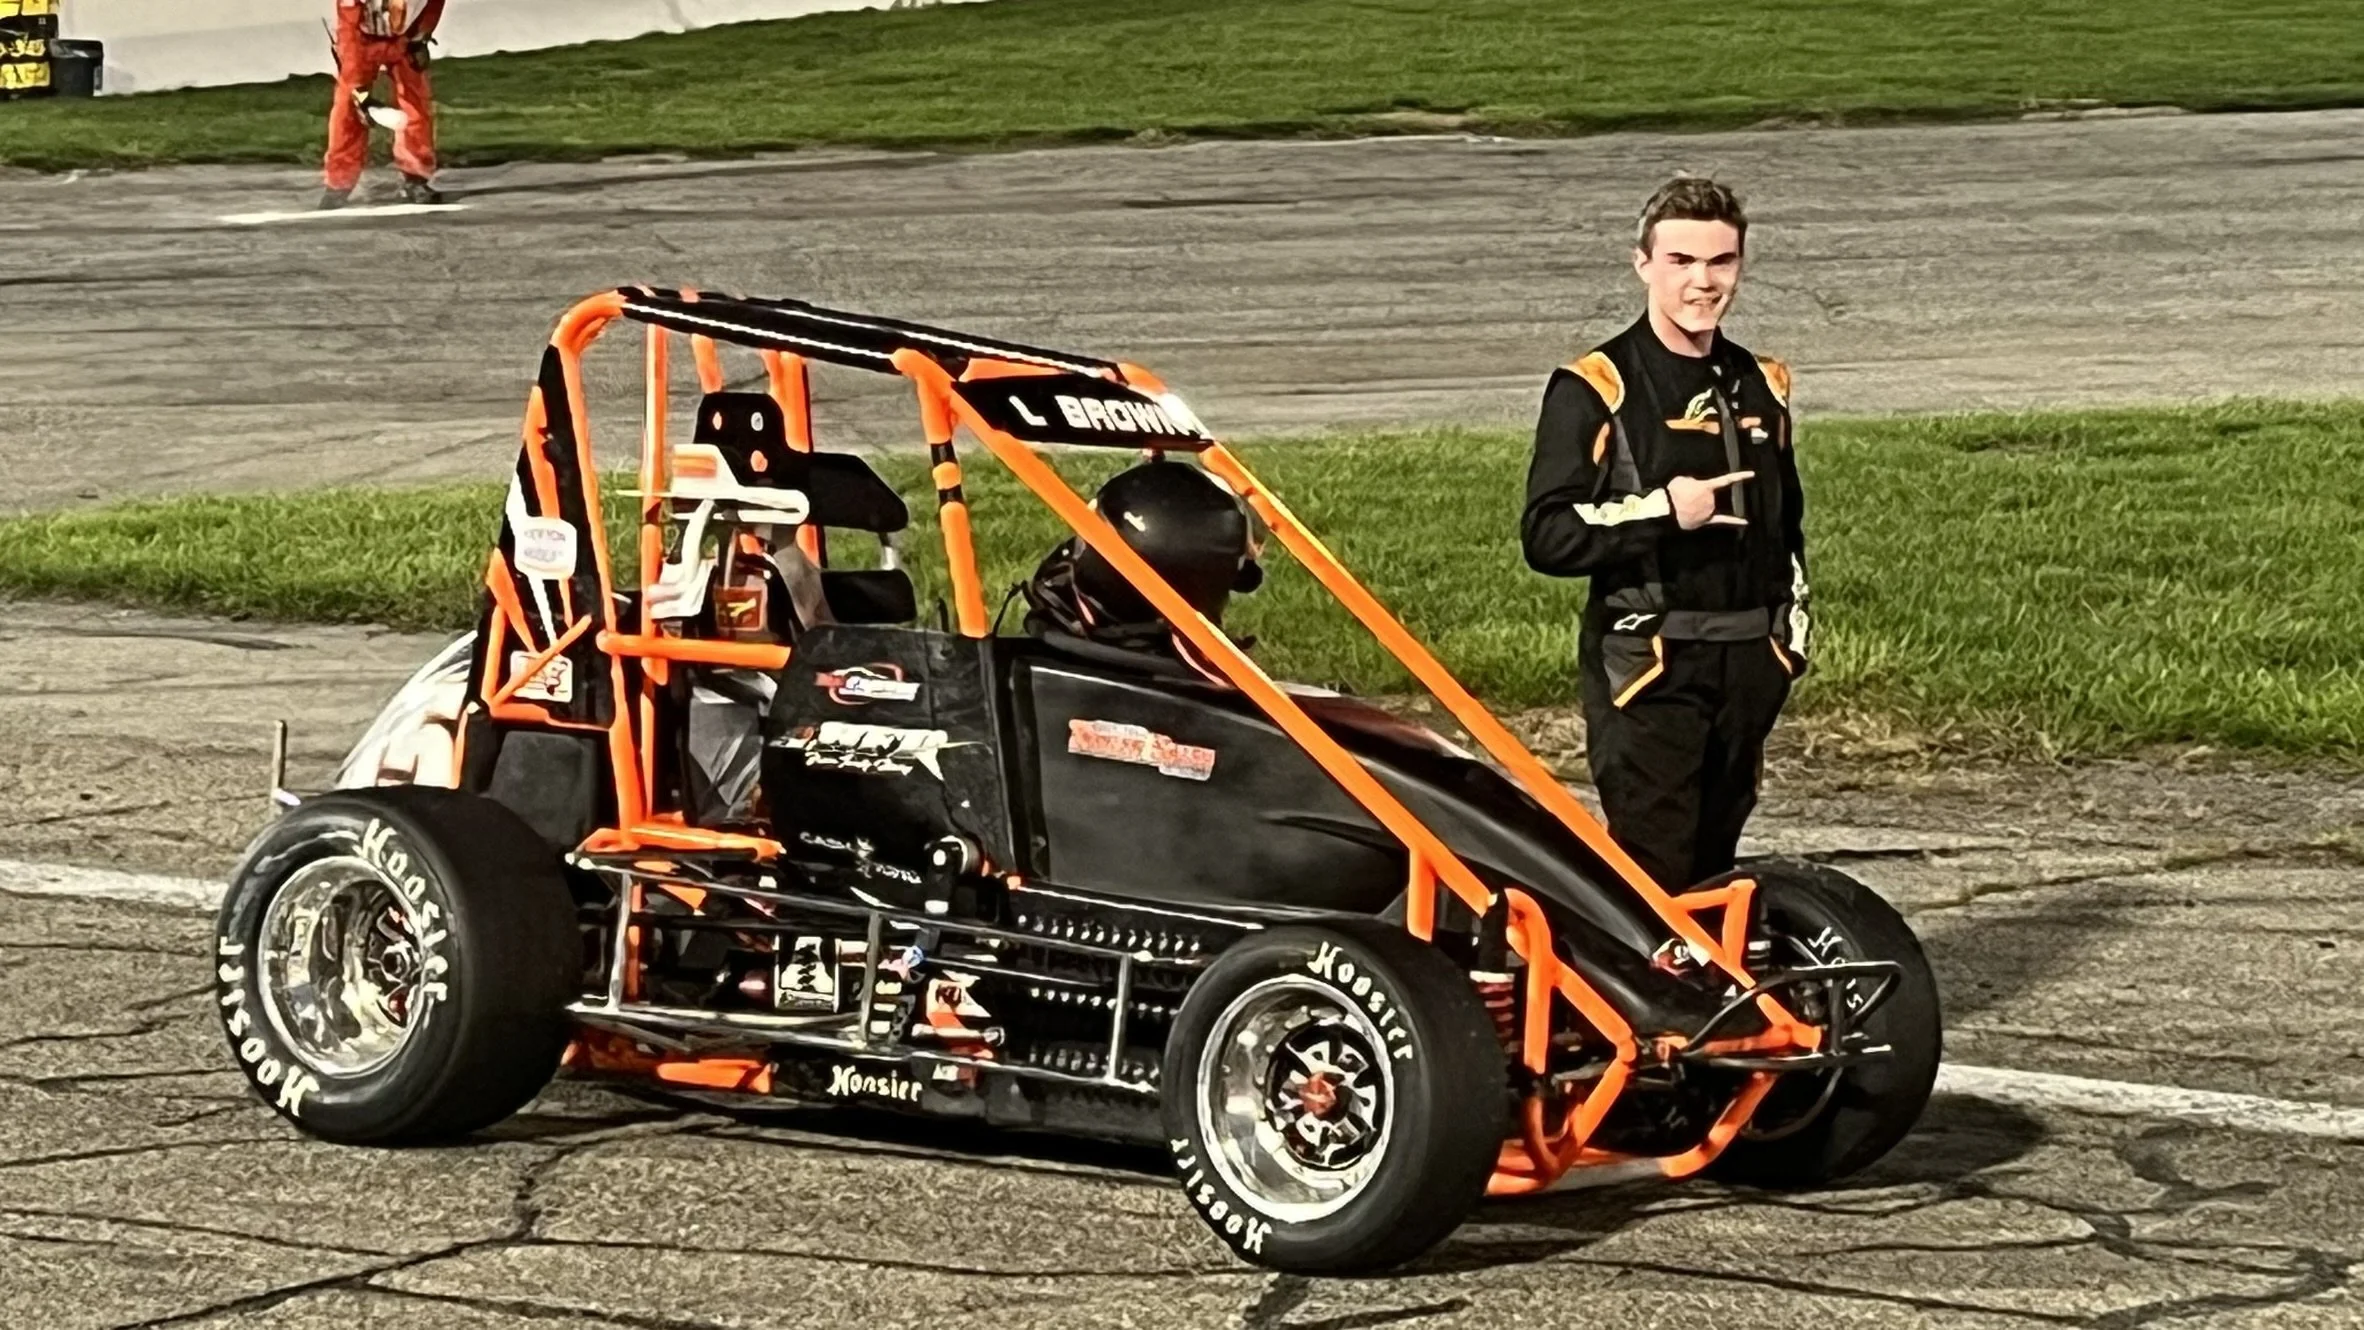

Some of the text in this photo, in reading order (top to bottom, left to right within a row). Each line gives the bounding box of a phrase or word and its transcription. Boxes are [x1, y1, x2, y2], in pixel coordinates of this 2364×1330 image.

[1009, 395, 1047, 426] L
[350, 818, 448, 1002] Hoosier
[218, 936, 320, 1117] Hoosier
[1307, 941, 1413, 1060] Hoosier
[826, 1065, 923, 1102] Hoosier
[1170, 1138, 1273, 1254] Hoosier
